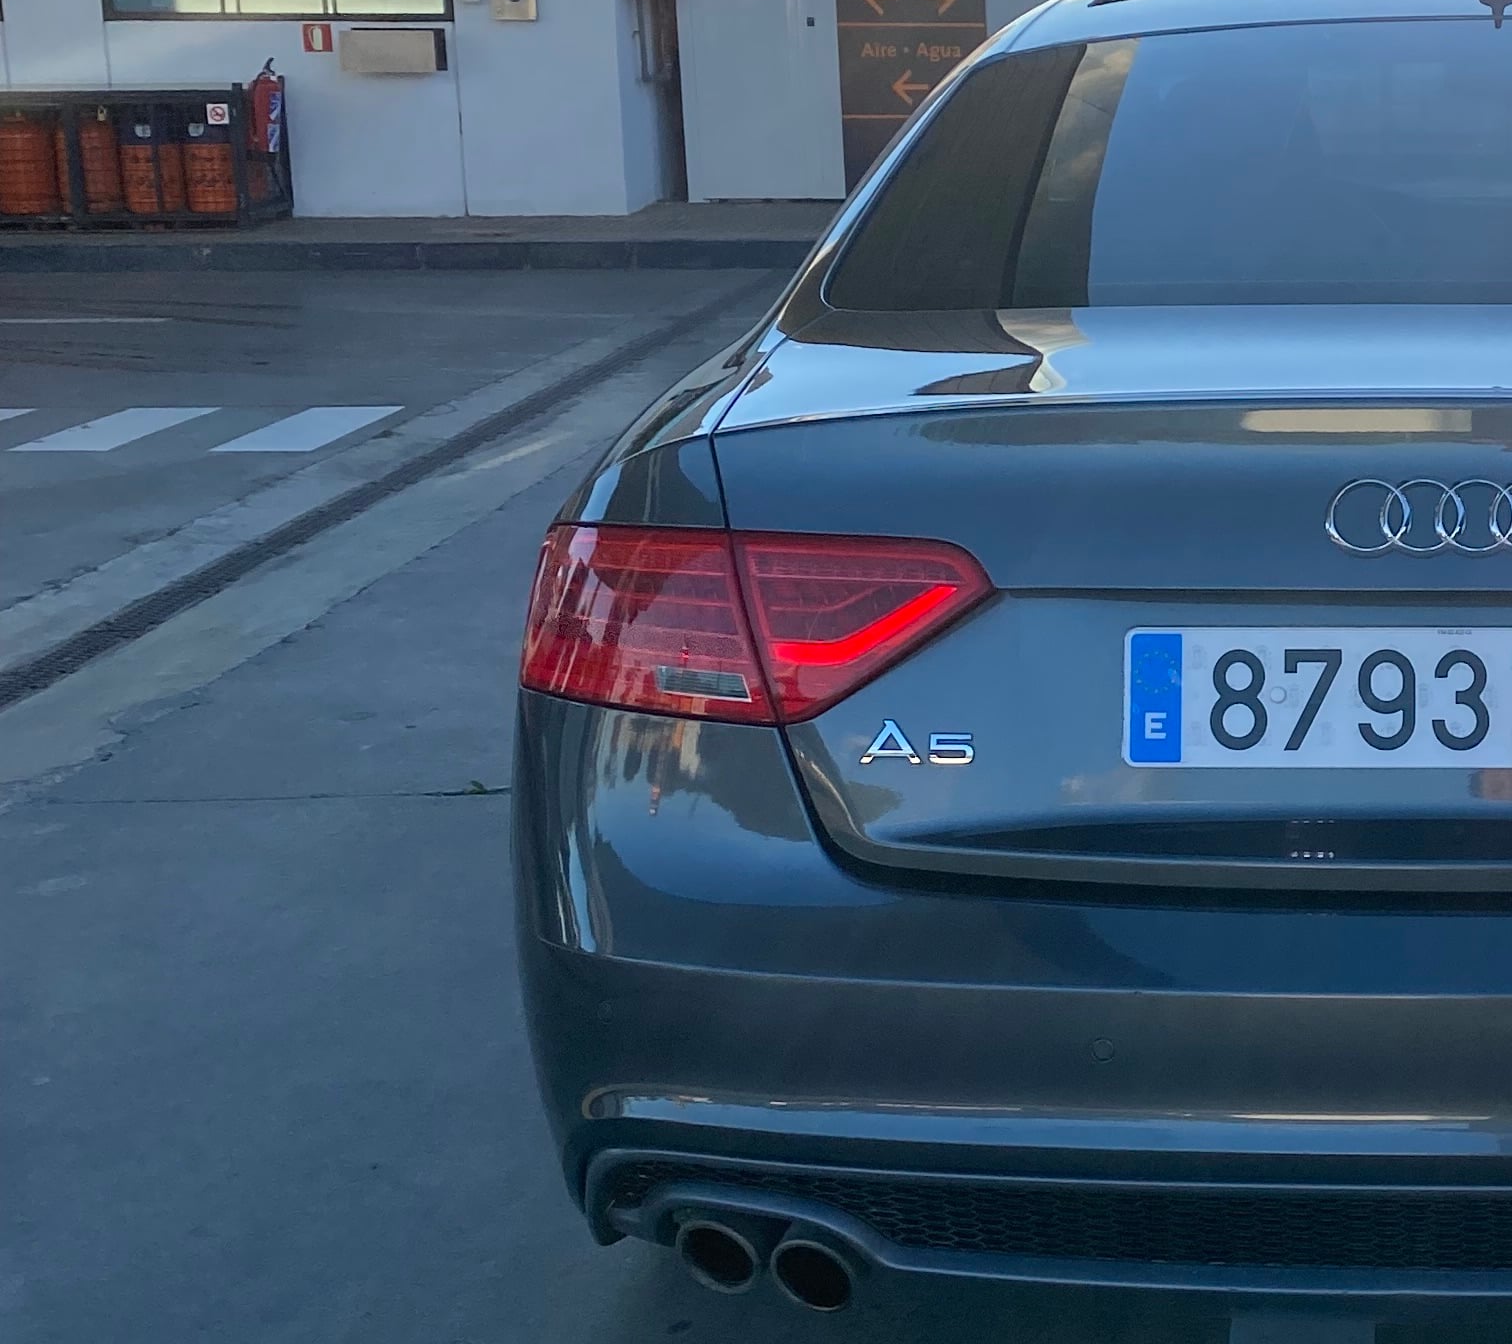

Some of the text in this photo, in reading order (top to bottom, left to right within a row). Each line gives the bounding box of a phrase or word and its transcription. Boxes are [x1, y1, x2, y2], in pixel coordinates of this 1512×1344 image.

[861, 42, 962, 63] Aire Agua
[1209, 648, 1491, 752] 8793
[859, 718, 976, 765] A5
[1143, 711, 1167, 740] E
